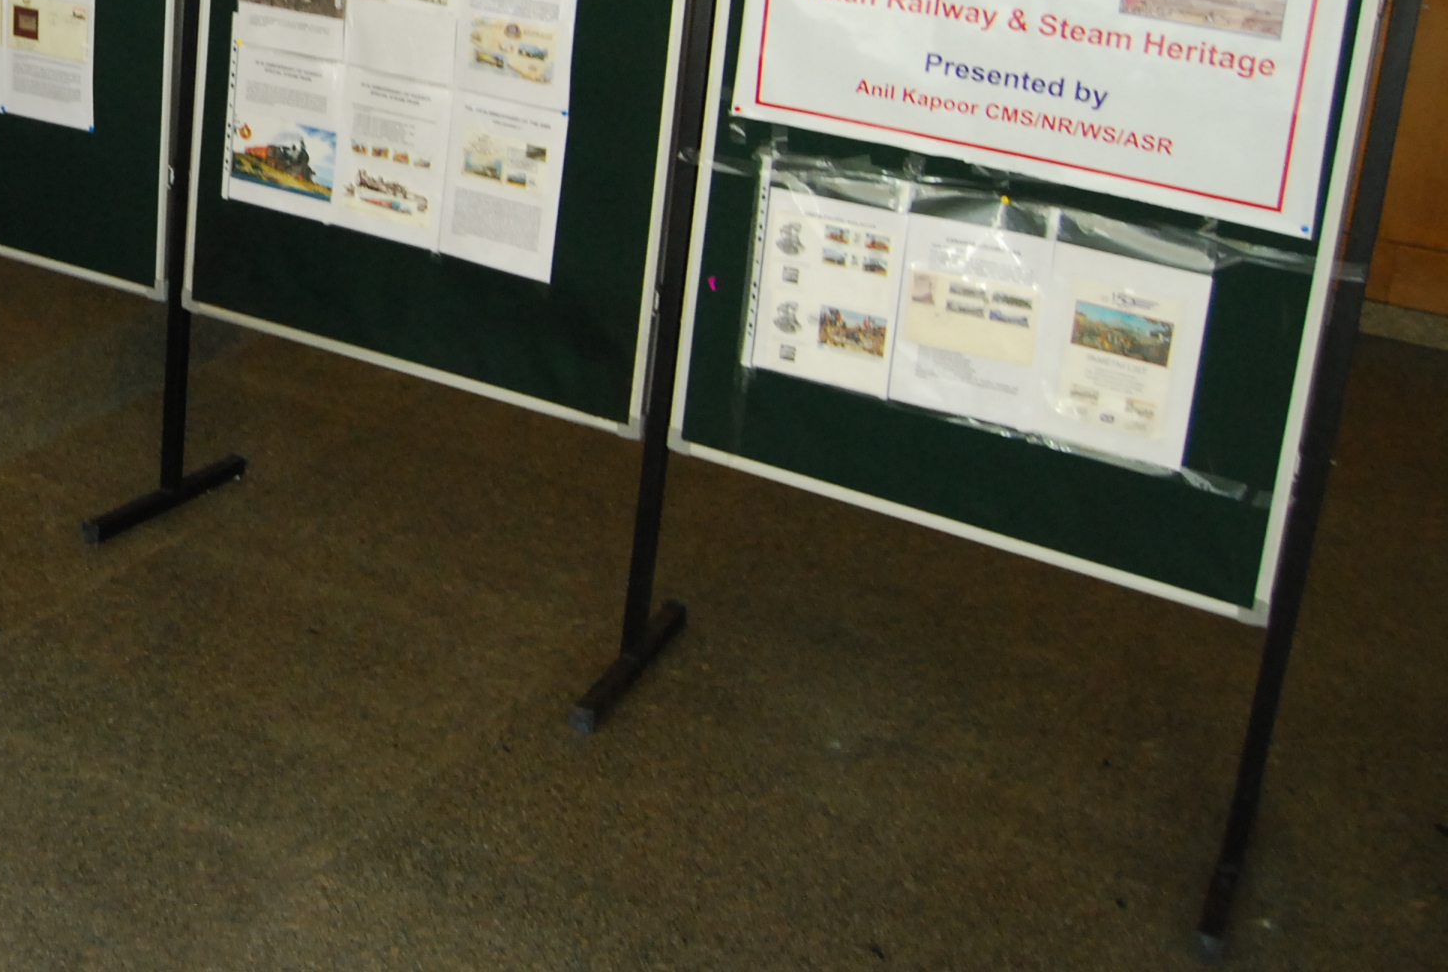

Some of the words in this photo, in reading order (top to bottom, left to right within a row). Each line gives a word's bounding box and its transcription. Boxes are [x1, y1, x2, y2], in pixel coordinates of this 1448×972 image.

[1008, 9, 1029, 32] &
[1039, 14, 1133, 50] Steam
[1144, 32, 1277, 79] Heritage
[925, 52, 1066, 98] Presented
[1074, 80, 1109, 110] by
[856, 79, 897, 100] Anil
[902, 87, 980, 115] Kapoor
[985, 103, 1174, 156] CMS/NR/WS/ASR
